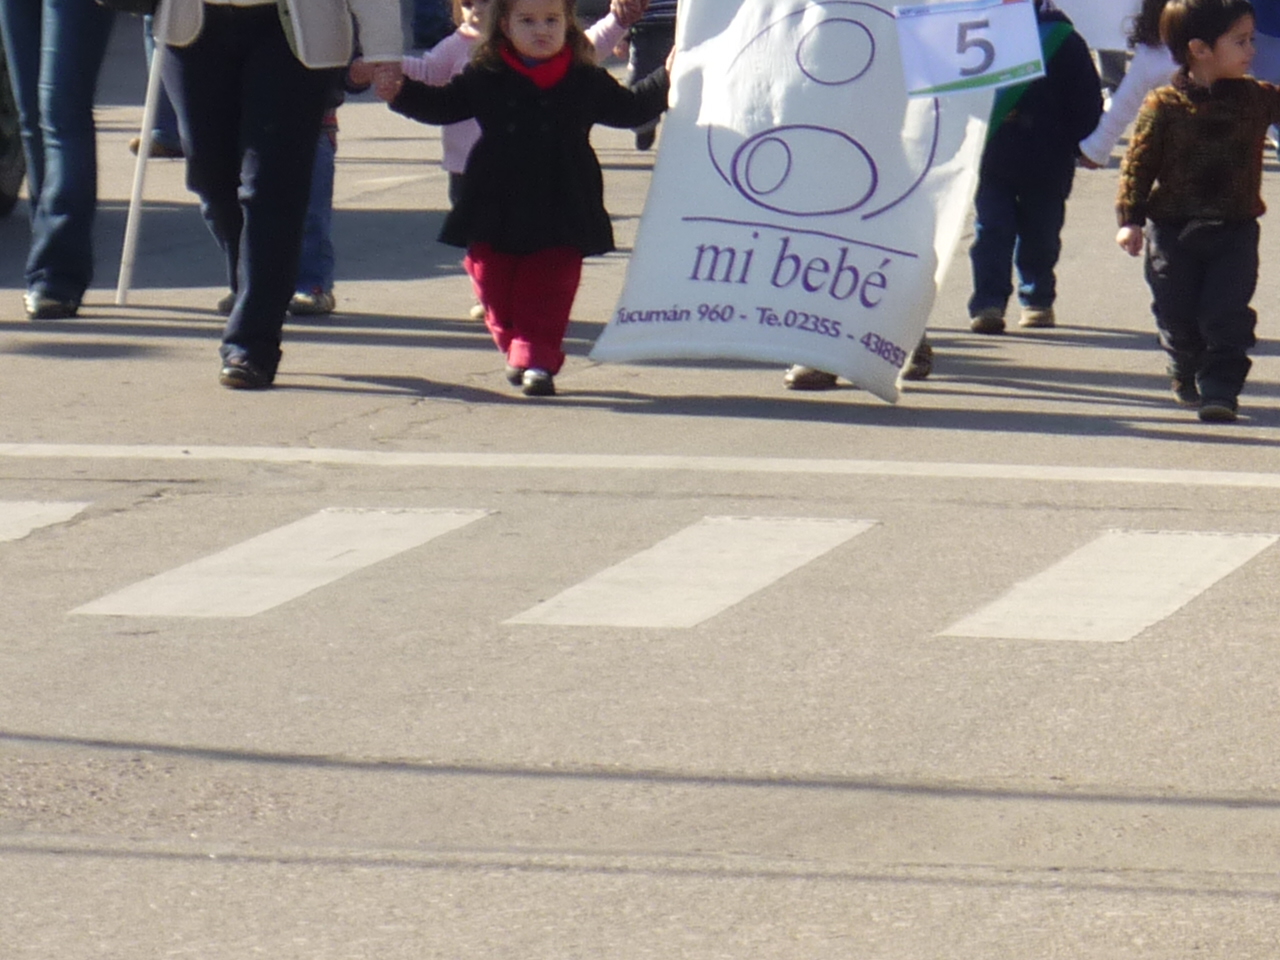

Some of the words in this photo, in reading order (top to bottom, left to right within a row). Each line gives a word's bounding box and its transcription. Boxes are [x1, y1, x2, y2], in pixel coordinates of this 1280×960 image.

[956, 19, 996, 77] 5
[688, 231, 759, 285] mi
[770, 236, 892, 309] bebé
[697, 303, 734, 323] 960
